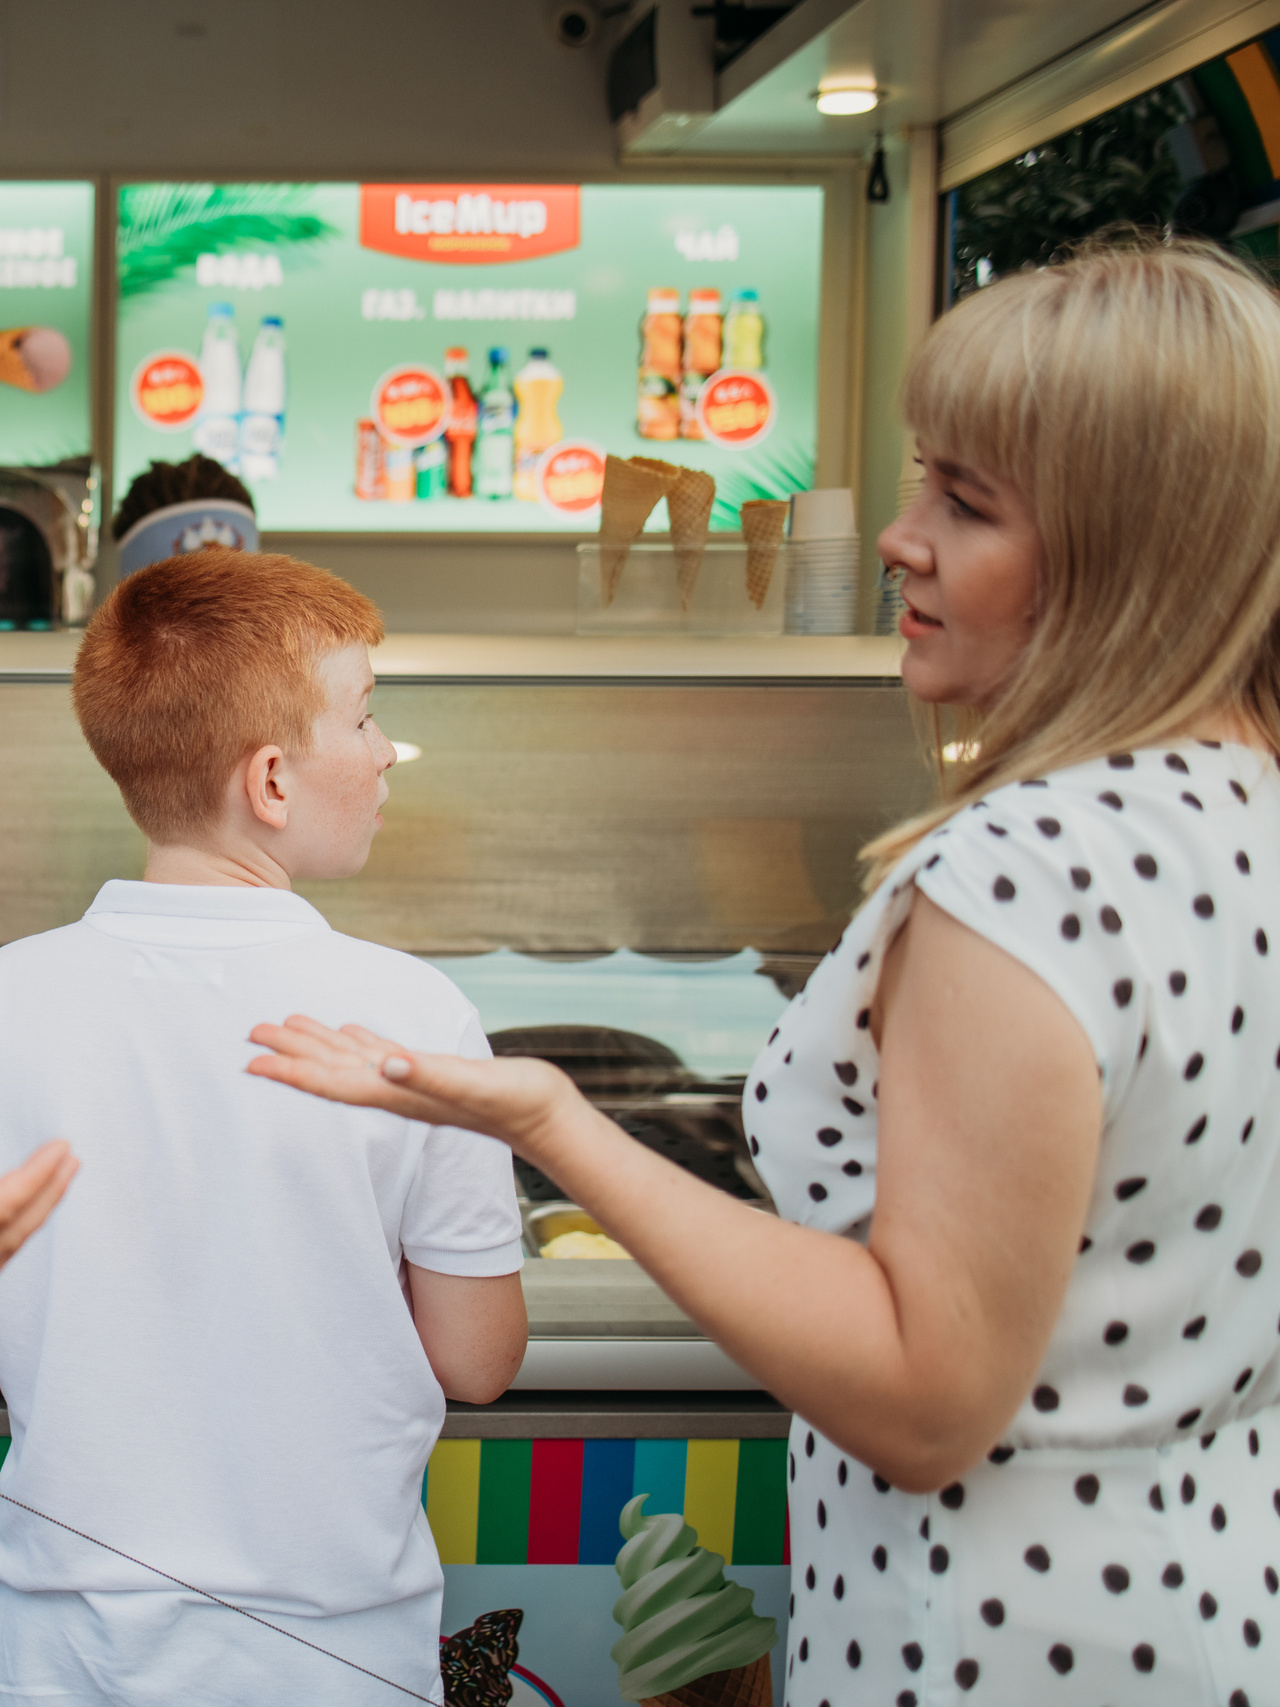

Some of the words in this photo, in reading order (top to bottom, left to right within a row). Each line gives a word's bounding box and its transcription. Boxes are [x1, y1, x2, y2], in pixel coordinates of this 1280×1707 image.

[675, 224, 739, 262] ЧАЙ
[197, 253, 282, 291] ВОДА
[434, 288, 576, 320] НАПИТКИ
